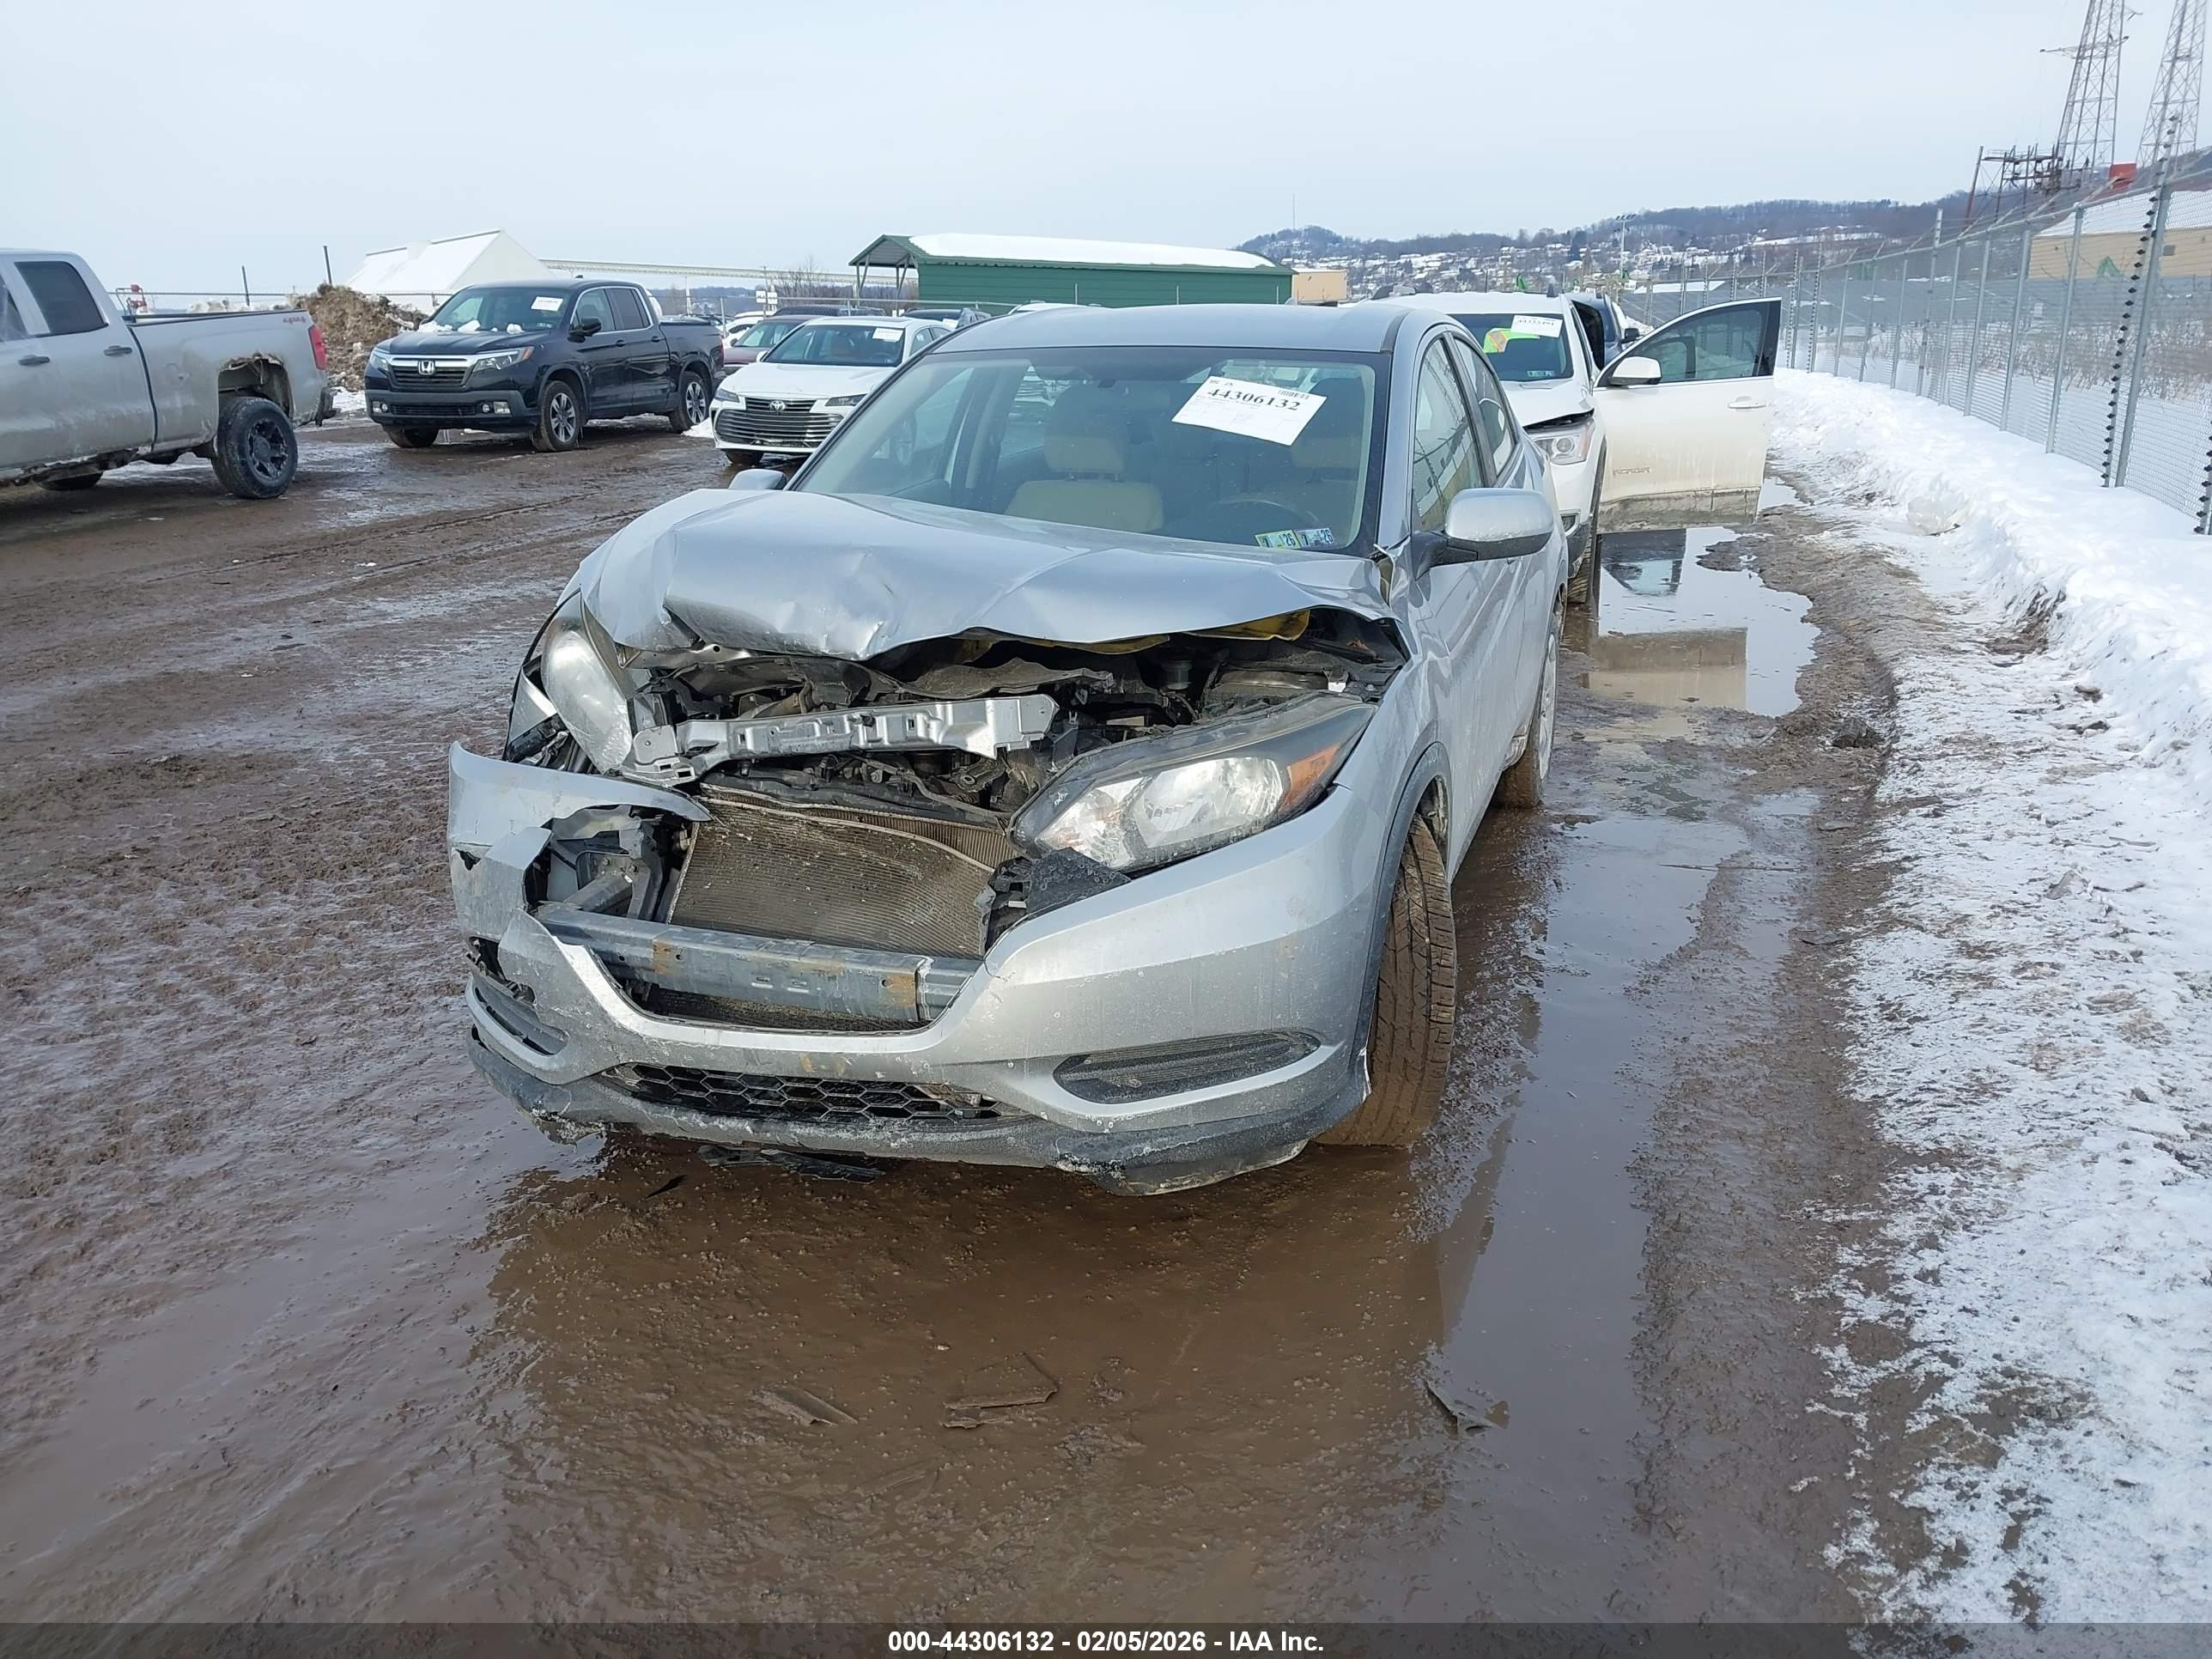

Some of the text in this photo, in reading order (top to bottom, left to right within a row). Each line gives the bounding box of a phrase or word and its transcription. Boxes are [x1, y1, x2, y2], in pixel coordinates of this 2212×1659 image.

[1207, 388, 1301, 410] 44306132
[1283, 532, 1297, 546] 26
[1320, 529, 1334, 544] 26
